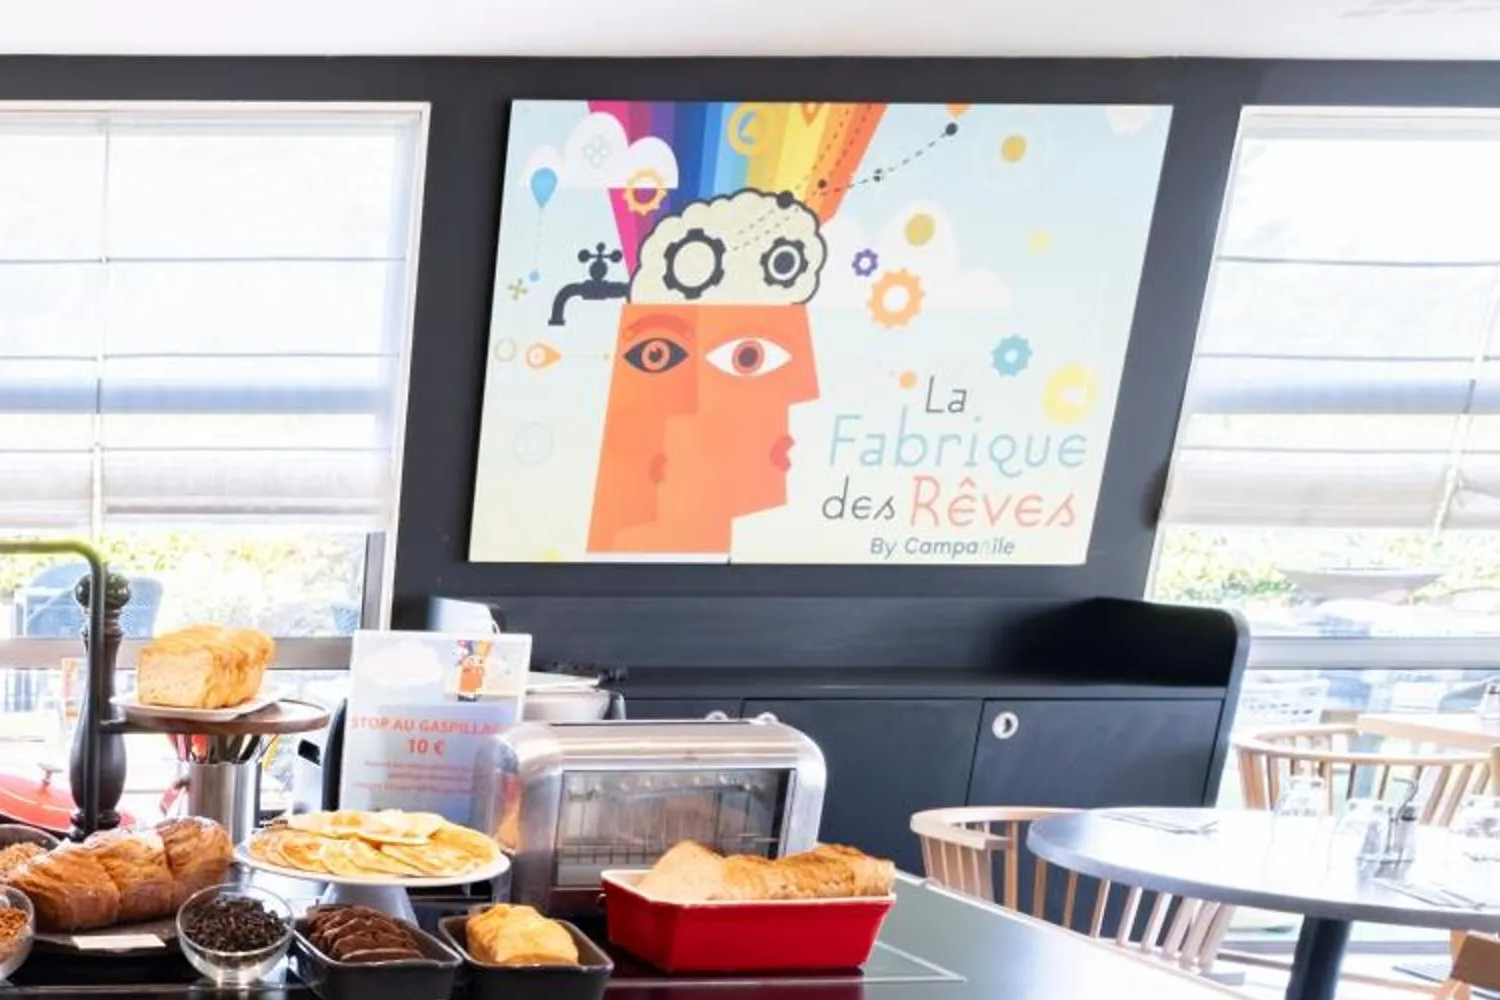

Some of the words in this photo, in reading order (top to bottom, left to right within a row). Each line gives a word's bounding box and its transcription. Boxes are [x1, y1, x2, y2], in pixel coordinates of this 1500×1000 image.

[925, 374, 968, 414] La
[828, 405, 1088, 479] Fabrique
[821, 474, 896, 521] des
[910, 474, 1077, 529] Rêves
[869, 537, 897, 560] By
[352, 716, 389, 731] STOP
[393, 718, 414, 732] AU
[409, 738, 428, 754] 10
